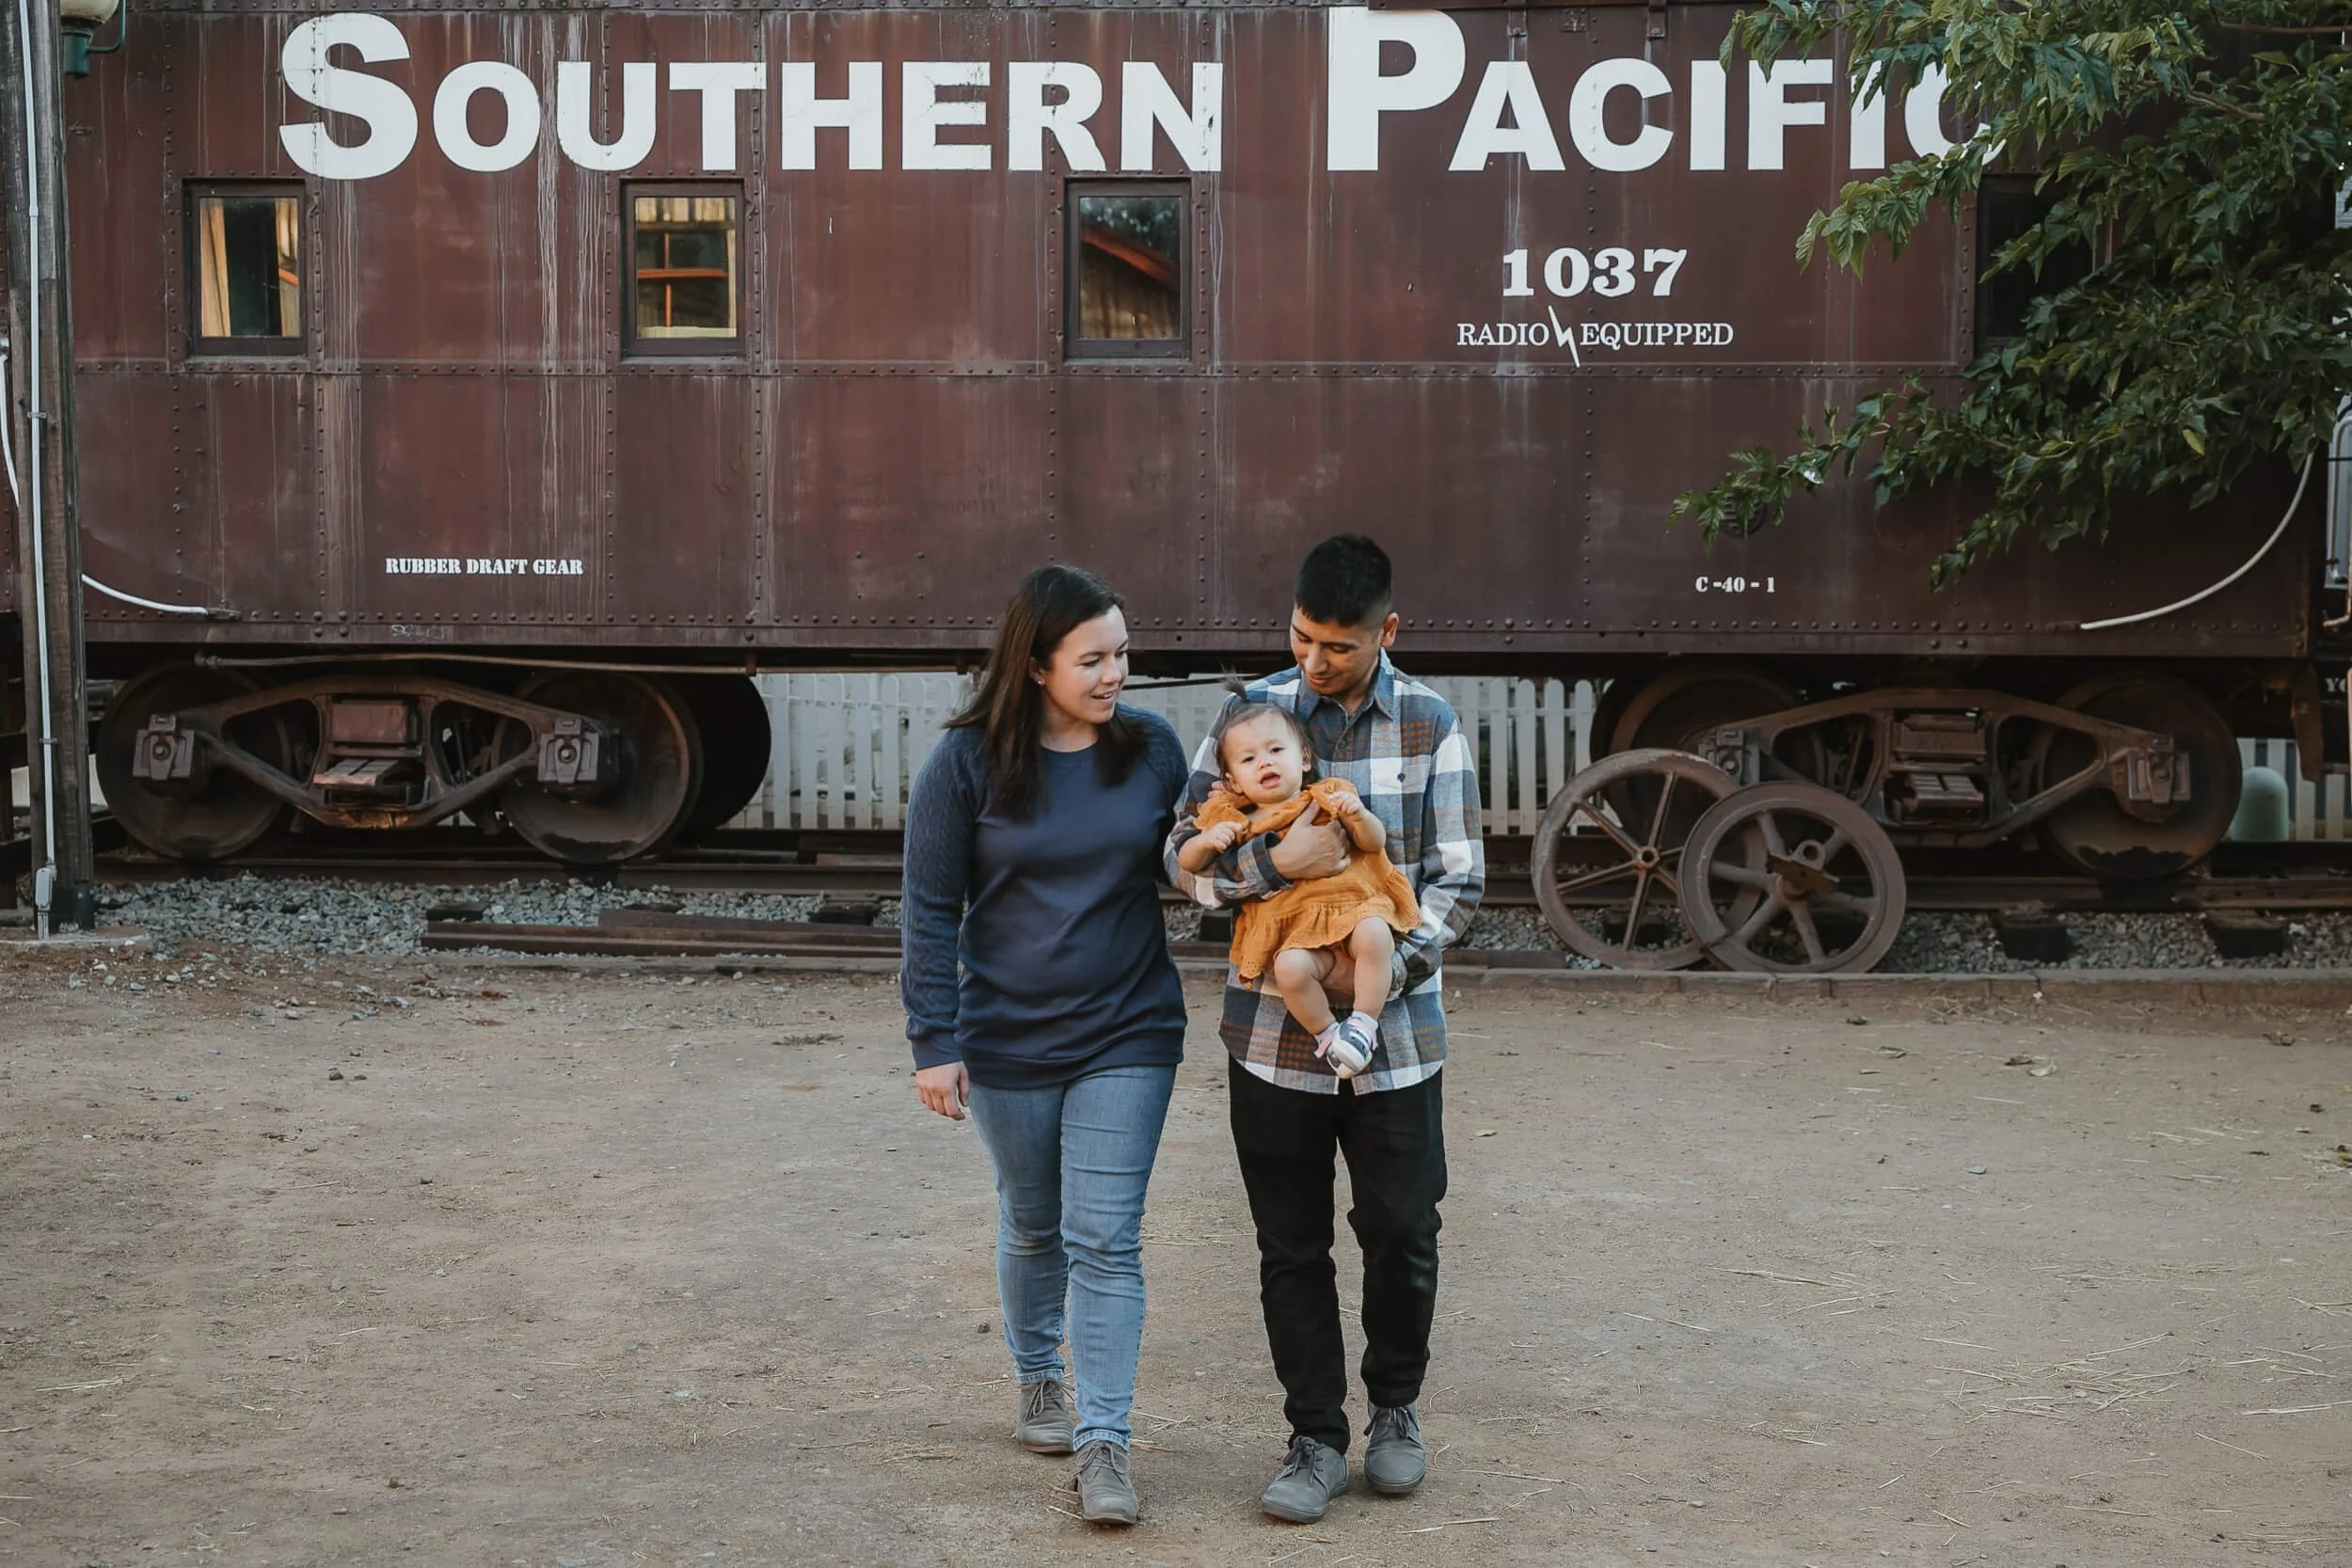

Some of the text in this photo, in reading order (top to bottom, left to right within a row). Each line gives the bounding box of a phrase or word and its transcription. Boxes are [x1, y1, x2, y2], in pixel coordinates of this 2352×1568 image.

[279, 7, 2007, 180] SOUTHERN PACIFIC
[1502, 247, 1688, 297] 1037
[1456, 323, 1734, 350] RADIO EQUIPPED
[386, 558, 584, 575] RUBBER DRAFT GEAR
